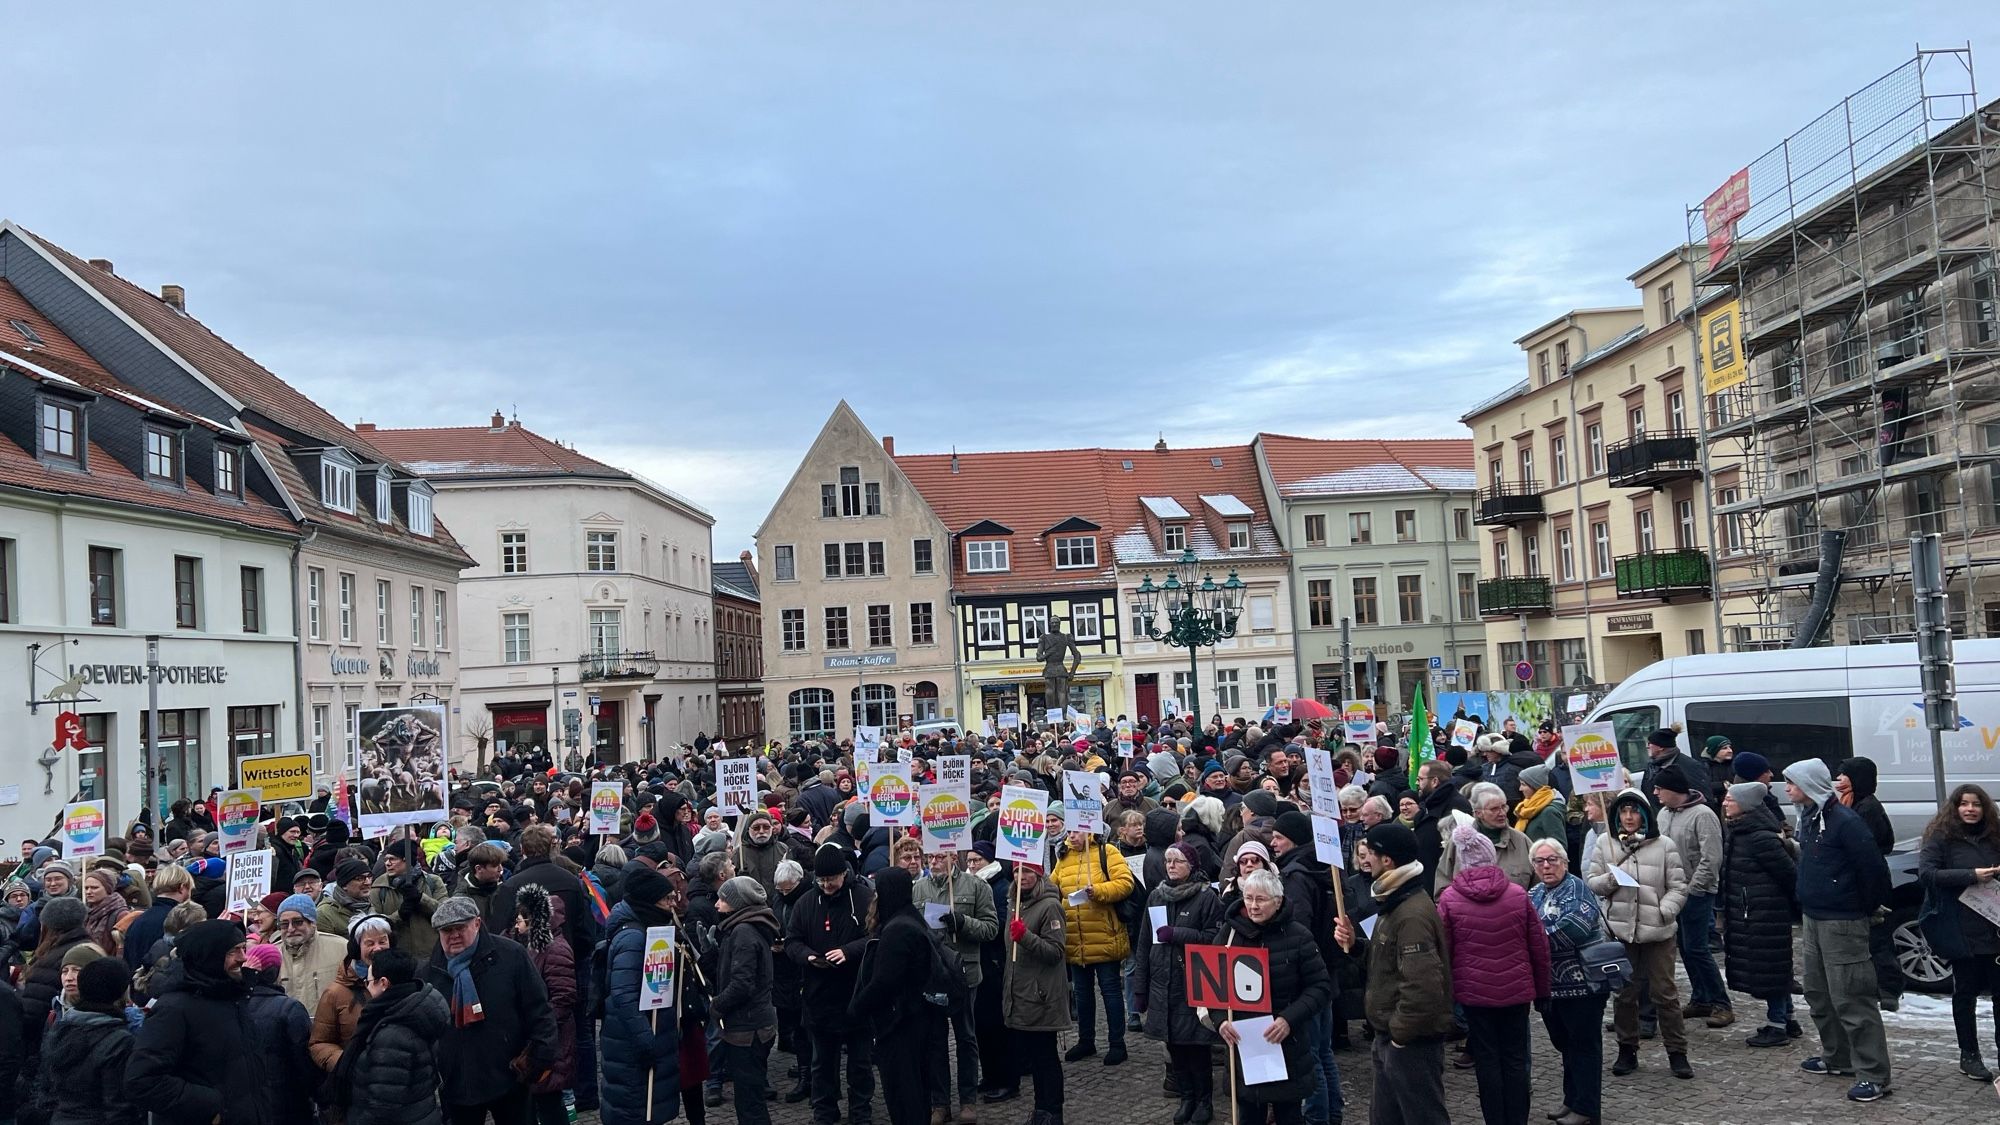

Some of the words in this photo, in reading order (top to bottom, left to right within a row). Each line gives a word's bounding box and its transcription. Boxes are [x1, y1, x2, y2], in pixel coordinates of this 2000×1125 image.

[1326, 642, 1403, 657] Inrmation
[69, 664, 226, 685] LOEWEN-POTHEKE
[723, 761, 749, 774] BJÖRN
[943, 758, 964, 769] BJÖRN
[244, 765, 309, 782] Wittstock
[723, 773, 750, 787] HÖCKE
[943, 769, 964, 780] HÖCKE
[880, 785, 905, 794] STIMME
[725, 790, 750, 806] NAZI
[876, 793, 896, 802] GEGEN
[886, 801, 900, 813] AFD
[928, 800, 961, 814] STOPPT
[1004, 808, 1040, 823] STOPPT
[1011, 821, 1033, 839] AFD
[235, 855, 264, 869] BJÖRN
[234, 867, 263, 881] HÖCKE
[233, 883, 262, 901] NAZI
[652, 964, 668, 983] AFD
[1190, 952, 1264, 1004] NO
